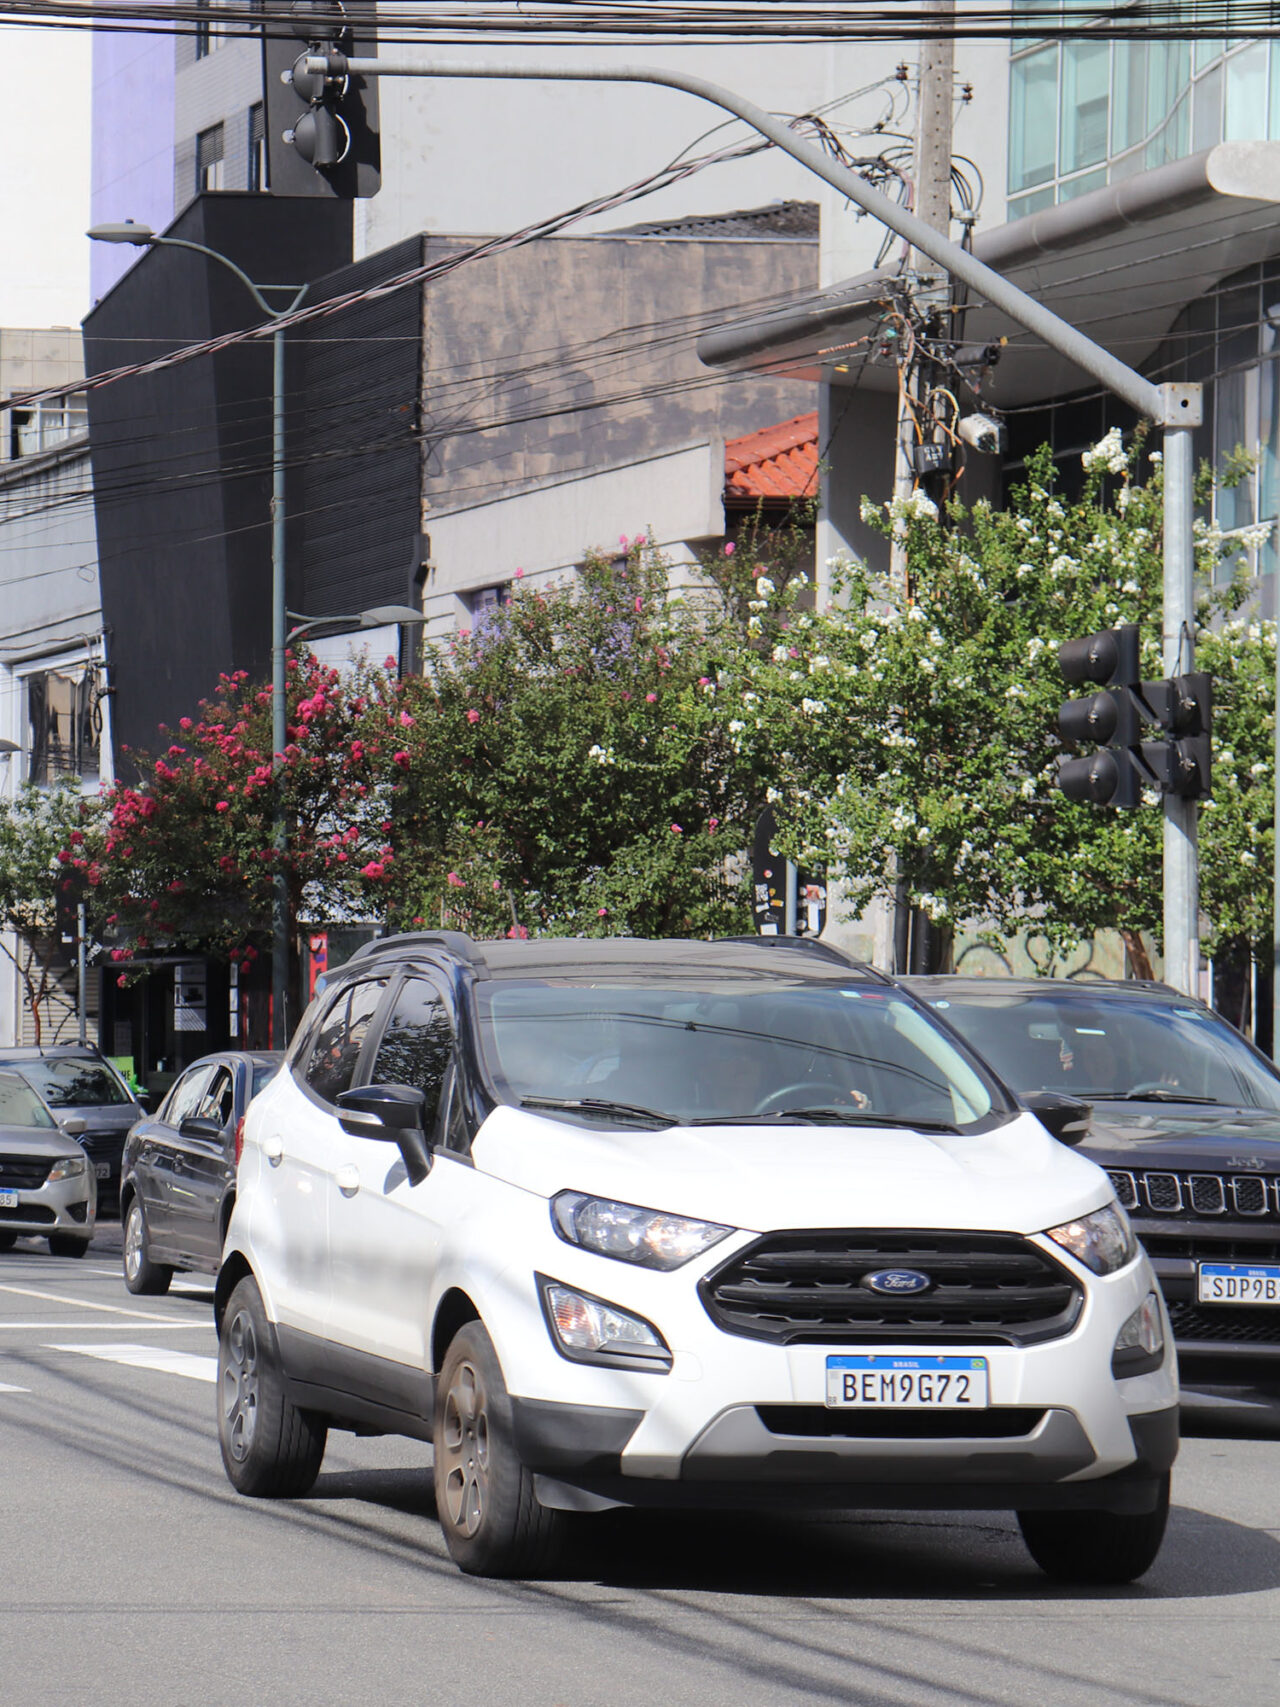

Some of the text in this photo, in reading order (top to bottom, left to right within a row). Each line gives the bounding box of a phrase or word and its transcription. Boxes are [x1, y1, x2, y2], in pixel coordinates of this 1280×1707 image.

[1226, 1153, 1266, 1169] Jeep
[884, 1274, 917, 1288] Ford
[1213, 1277, 1280, 1299] SDP9B
[842, 1373, 970, 1403] BEM9G72
